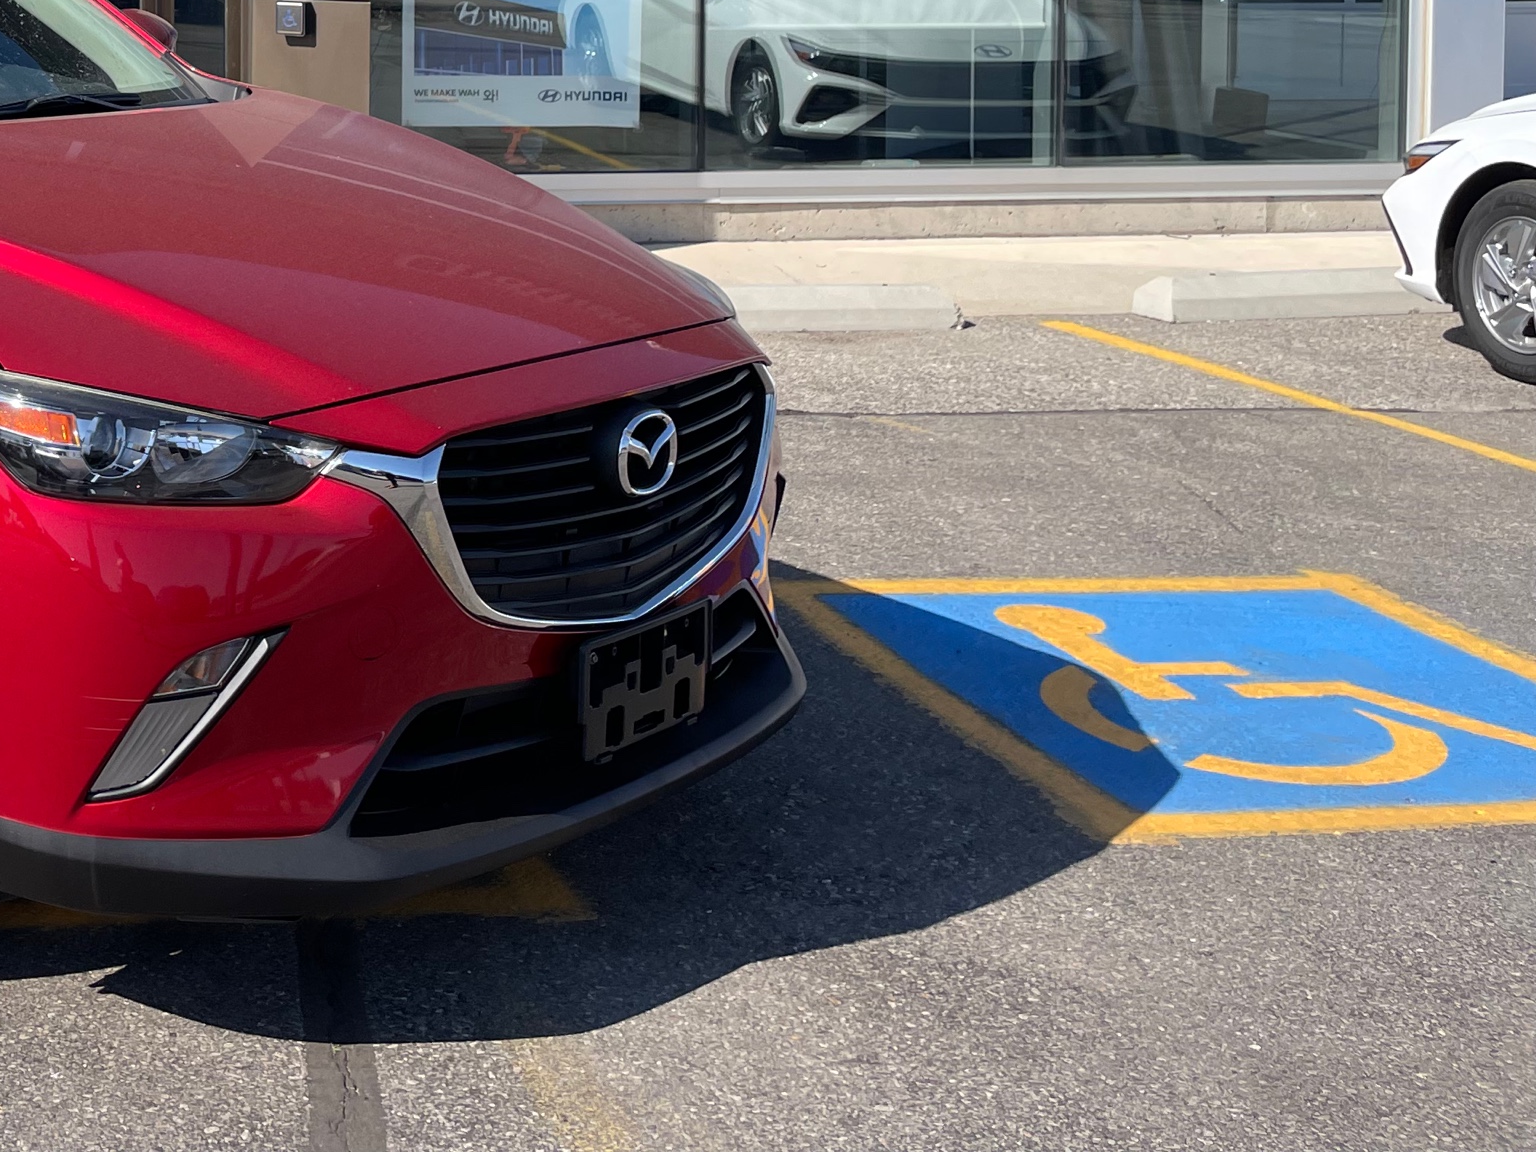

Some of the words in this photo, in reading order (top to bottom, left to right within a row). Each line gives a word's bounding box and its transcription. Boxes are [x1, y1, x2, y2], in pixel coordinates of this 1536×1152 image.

[488, 9, 554, 35] HYUNDAI
[413, 89, 429, 97] WE
[430, 89, 457, 97] MAKE
[458, 89, 480, 97] WAH
[564, 91, 628, 103] HYUNDAI
